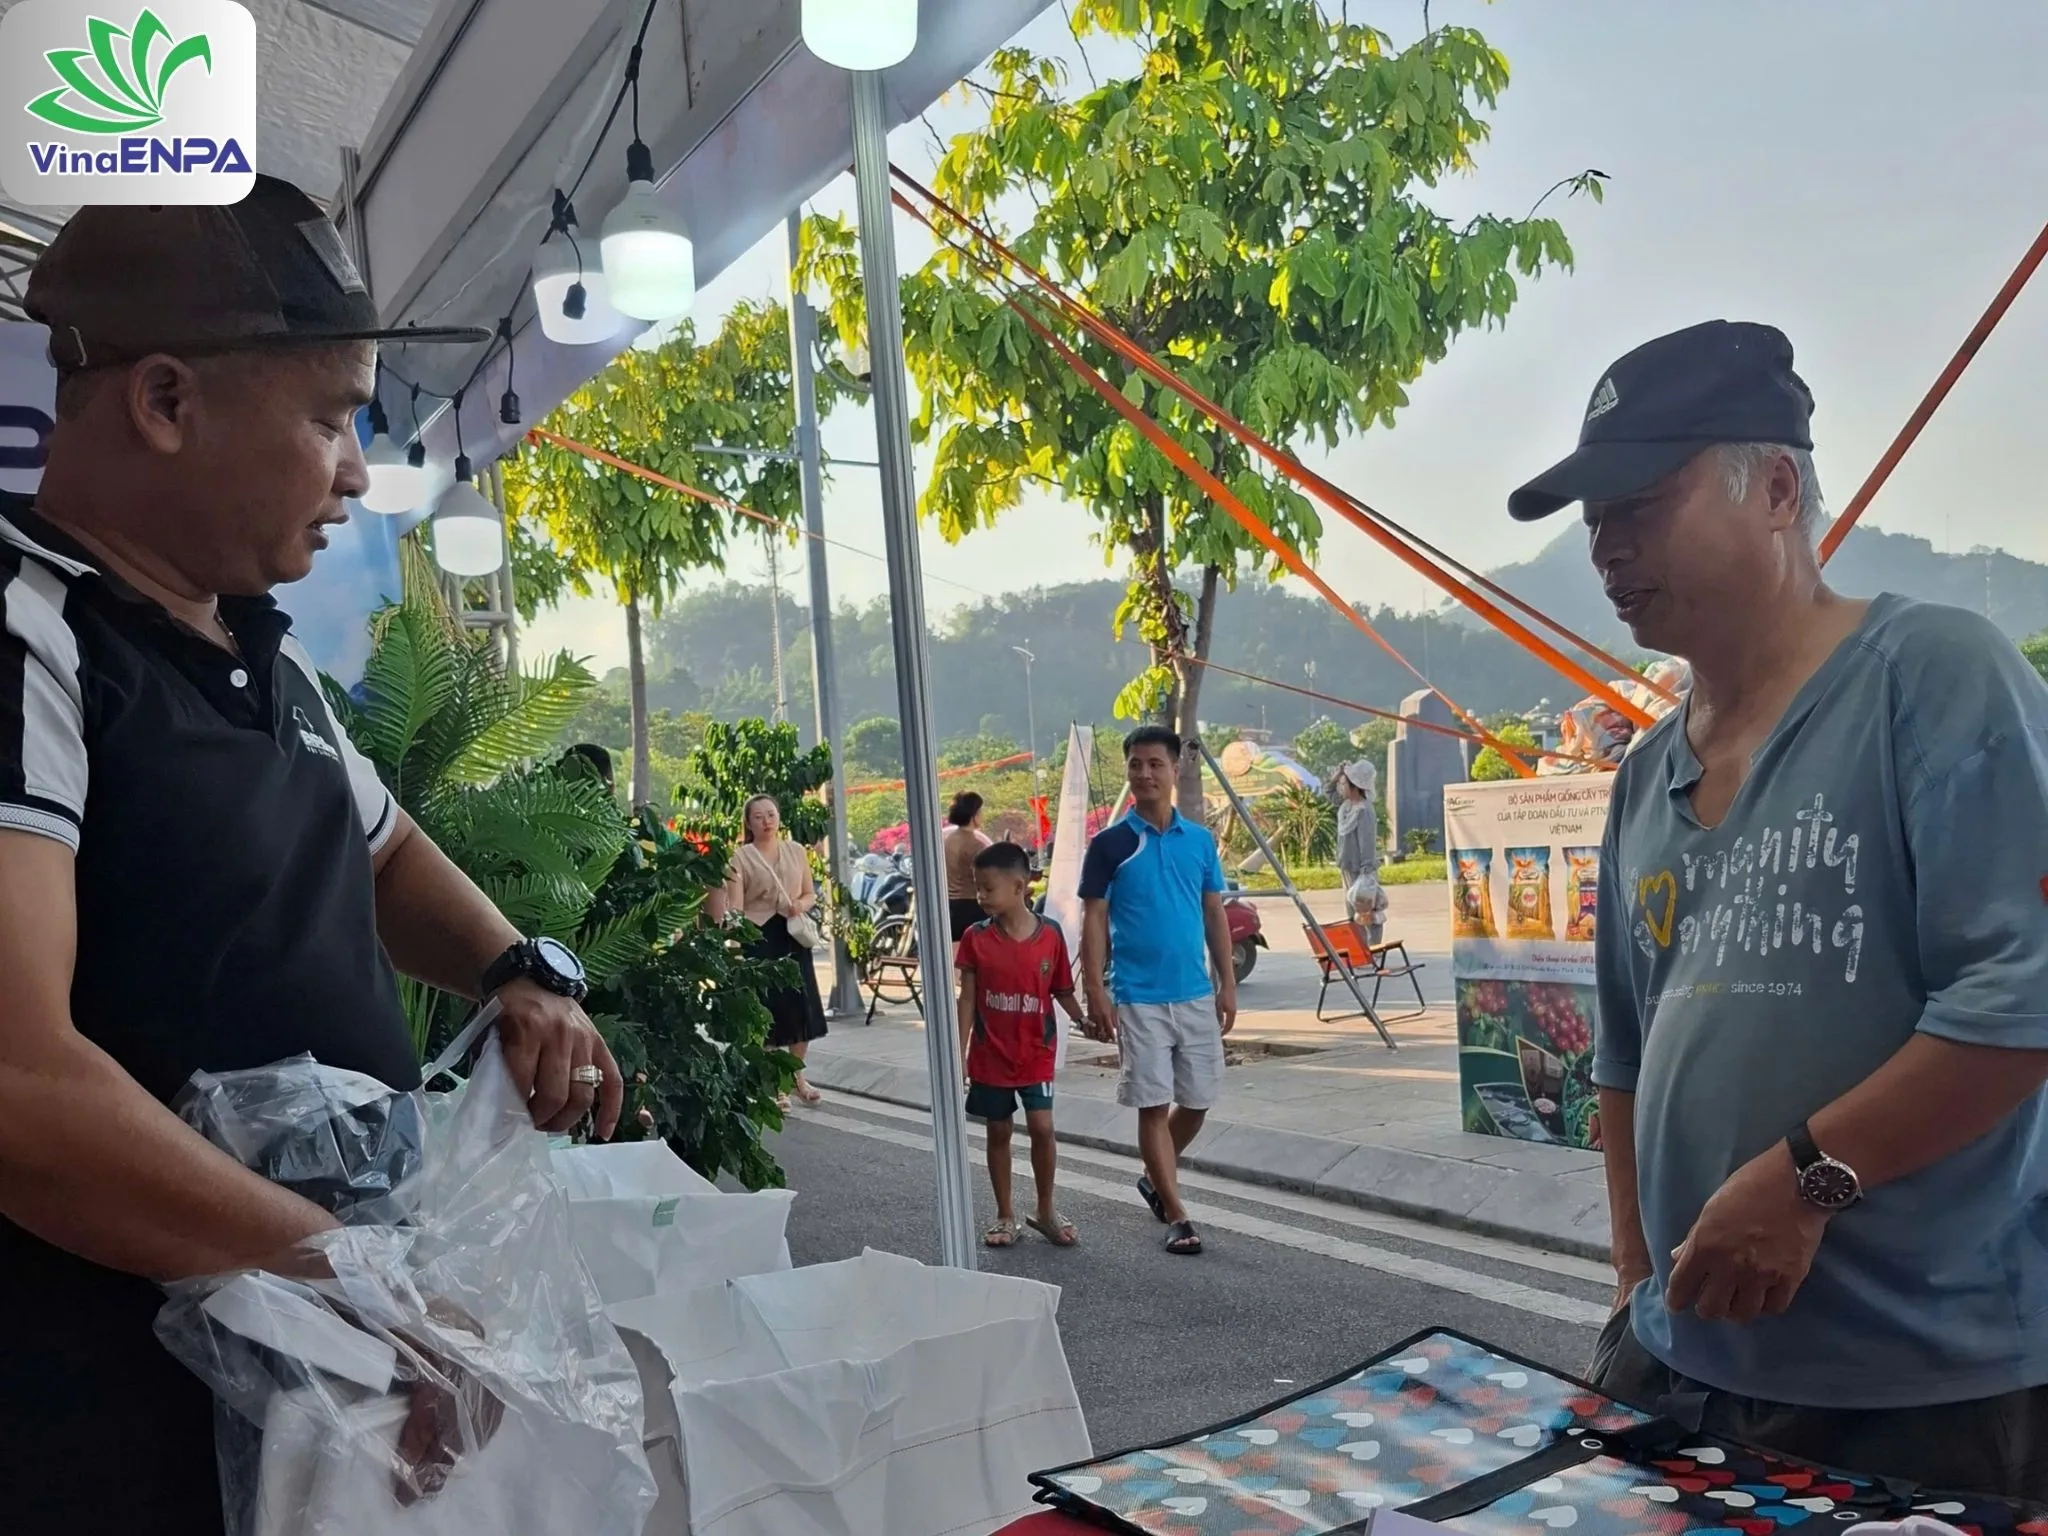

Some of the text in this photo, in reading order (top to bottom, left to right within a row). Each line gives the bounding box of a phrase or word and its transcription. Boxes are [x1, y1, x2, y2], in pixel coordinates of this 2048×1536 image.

[1730, 980, 1765, 994] since
[1767, 981, 1803, 996] 1974
[985, 989, 1021, 1012] Football
